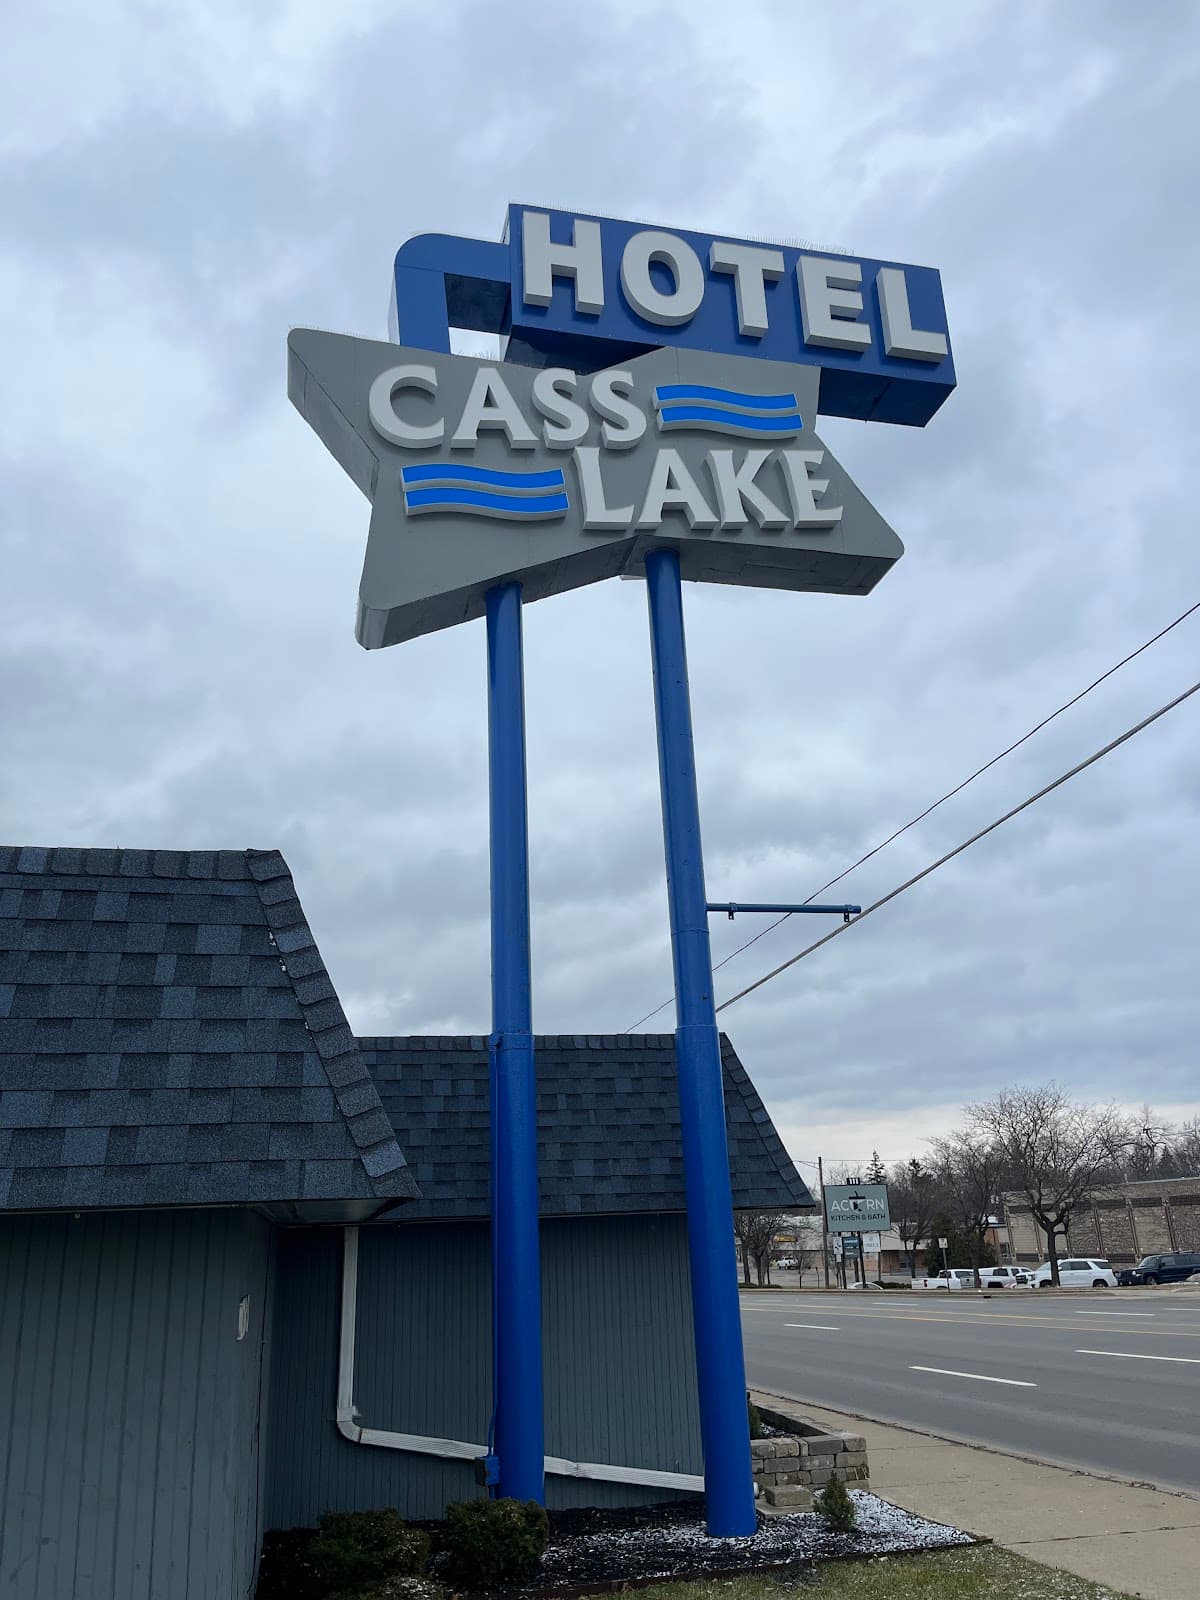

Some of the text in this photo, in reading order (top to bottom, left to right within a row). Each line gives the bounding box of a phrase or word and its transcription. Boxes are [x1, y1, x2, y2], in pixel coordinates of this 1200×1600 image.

[522, 211, 948, 362] HOTEL
[368, 363, 648, 450] CASS
[573, 445, 844, 531] LAKE
[831, 1213, 860, 1221] KITCHEN
[861, 1213, 867, 1221] &
